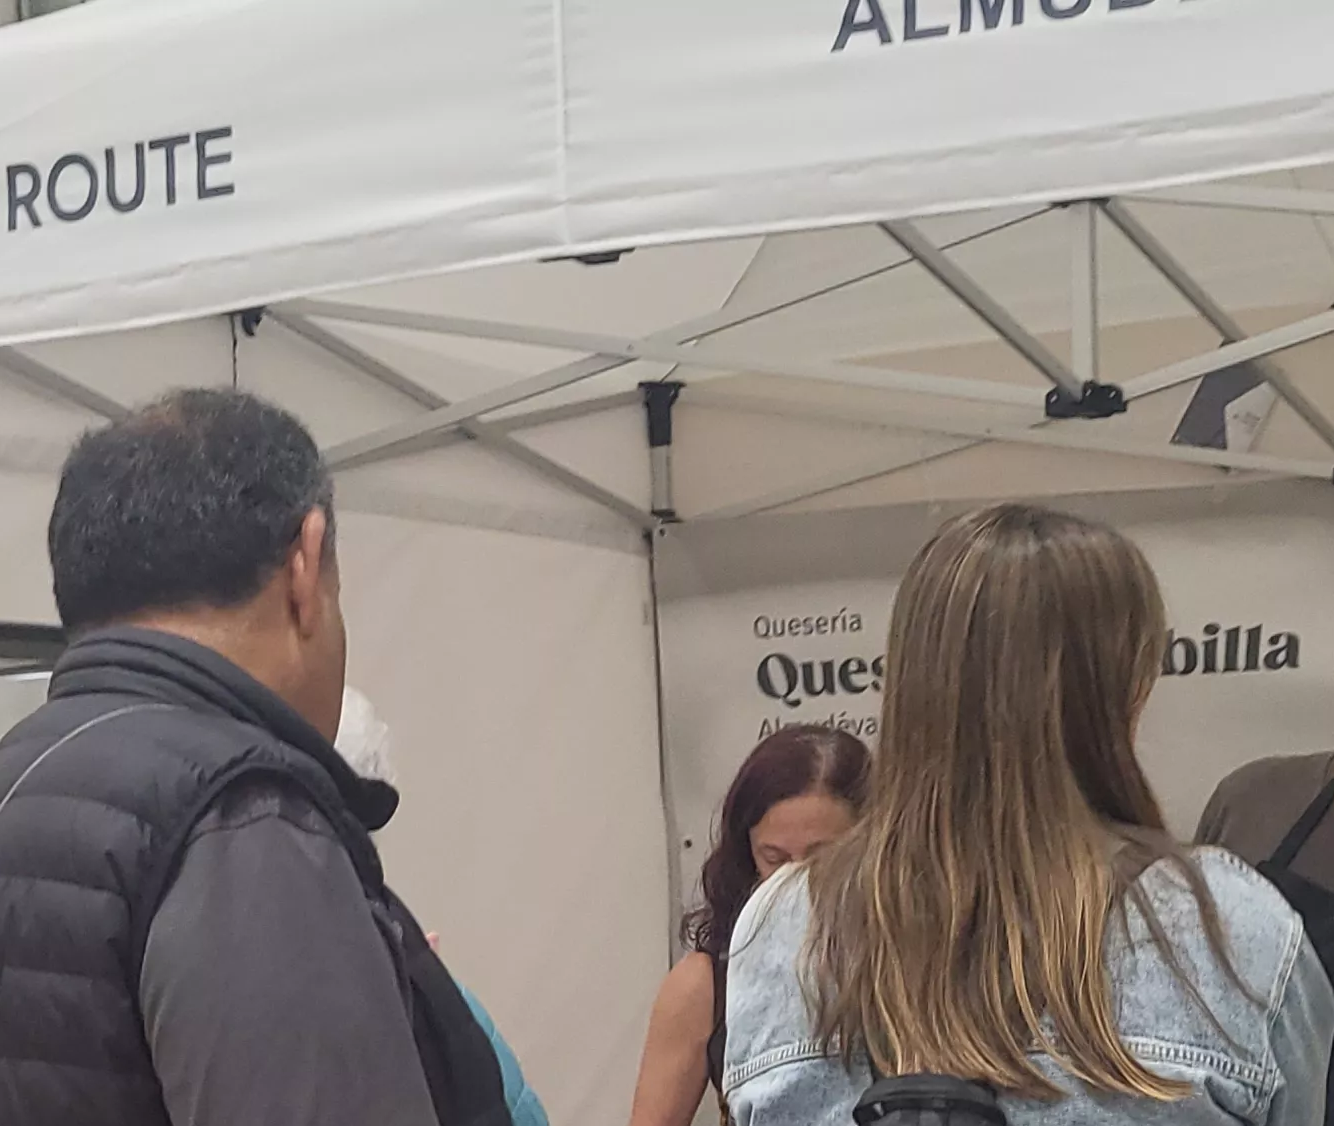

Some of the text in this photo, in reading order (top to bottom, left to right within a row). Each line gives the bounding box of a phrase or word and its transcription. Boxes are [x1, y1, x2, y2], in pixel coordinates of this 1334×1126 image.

[5, 125, 236, 232] ROUTE
[753, 607, 863, 639] Quesería
[1160, 621, 1302, 676] billa
